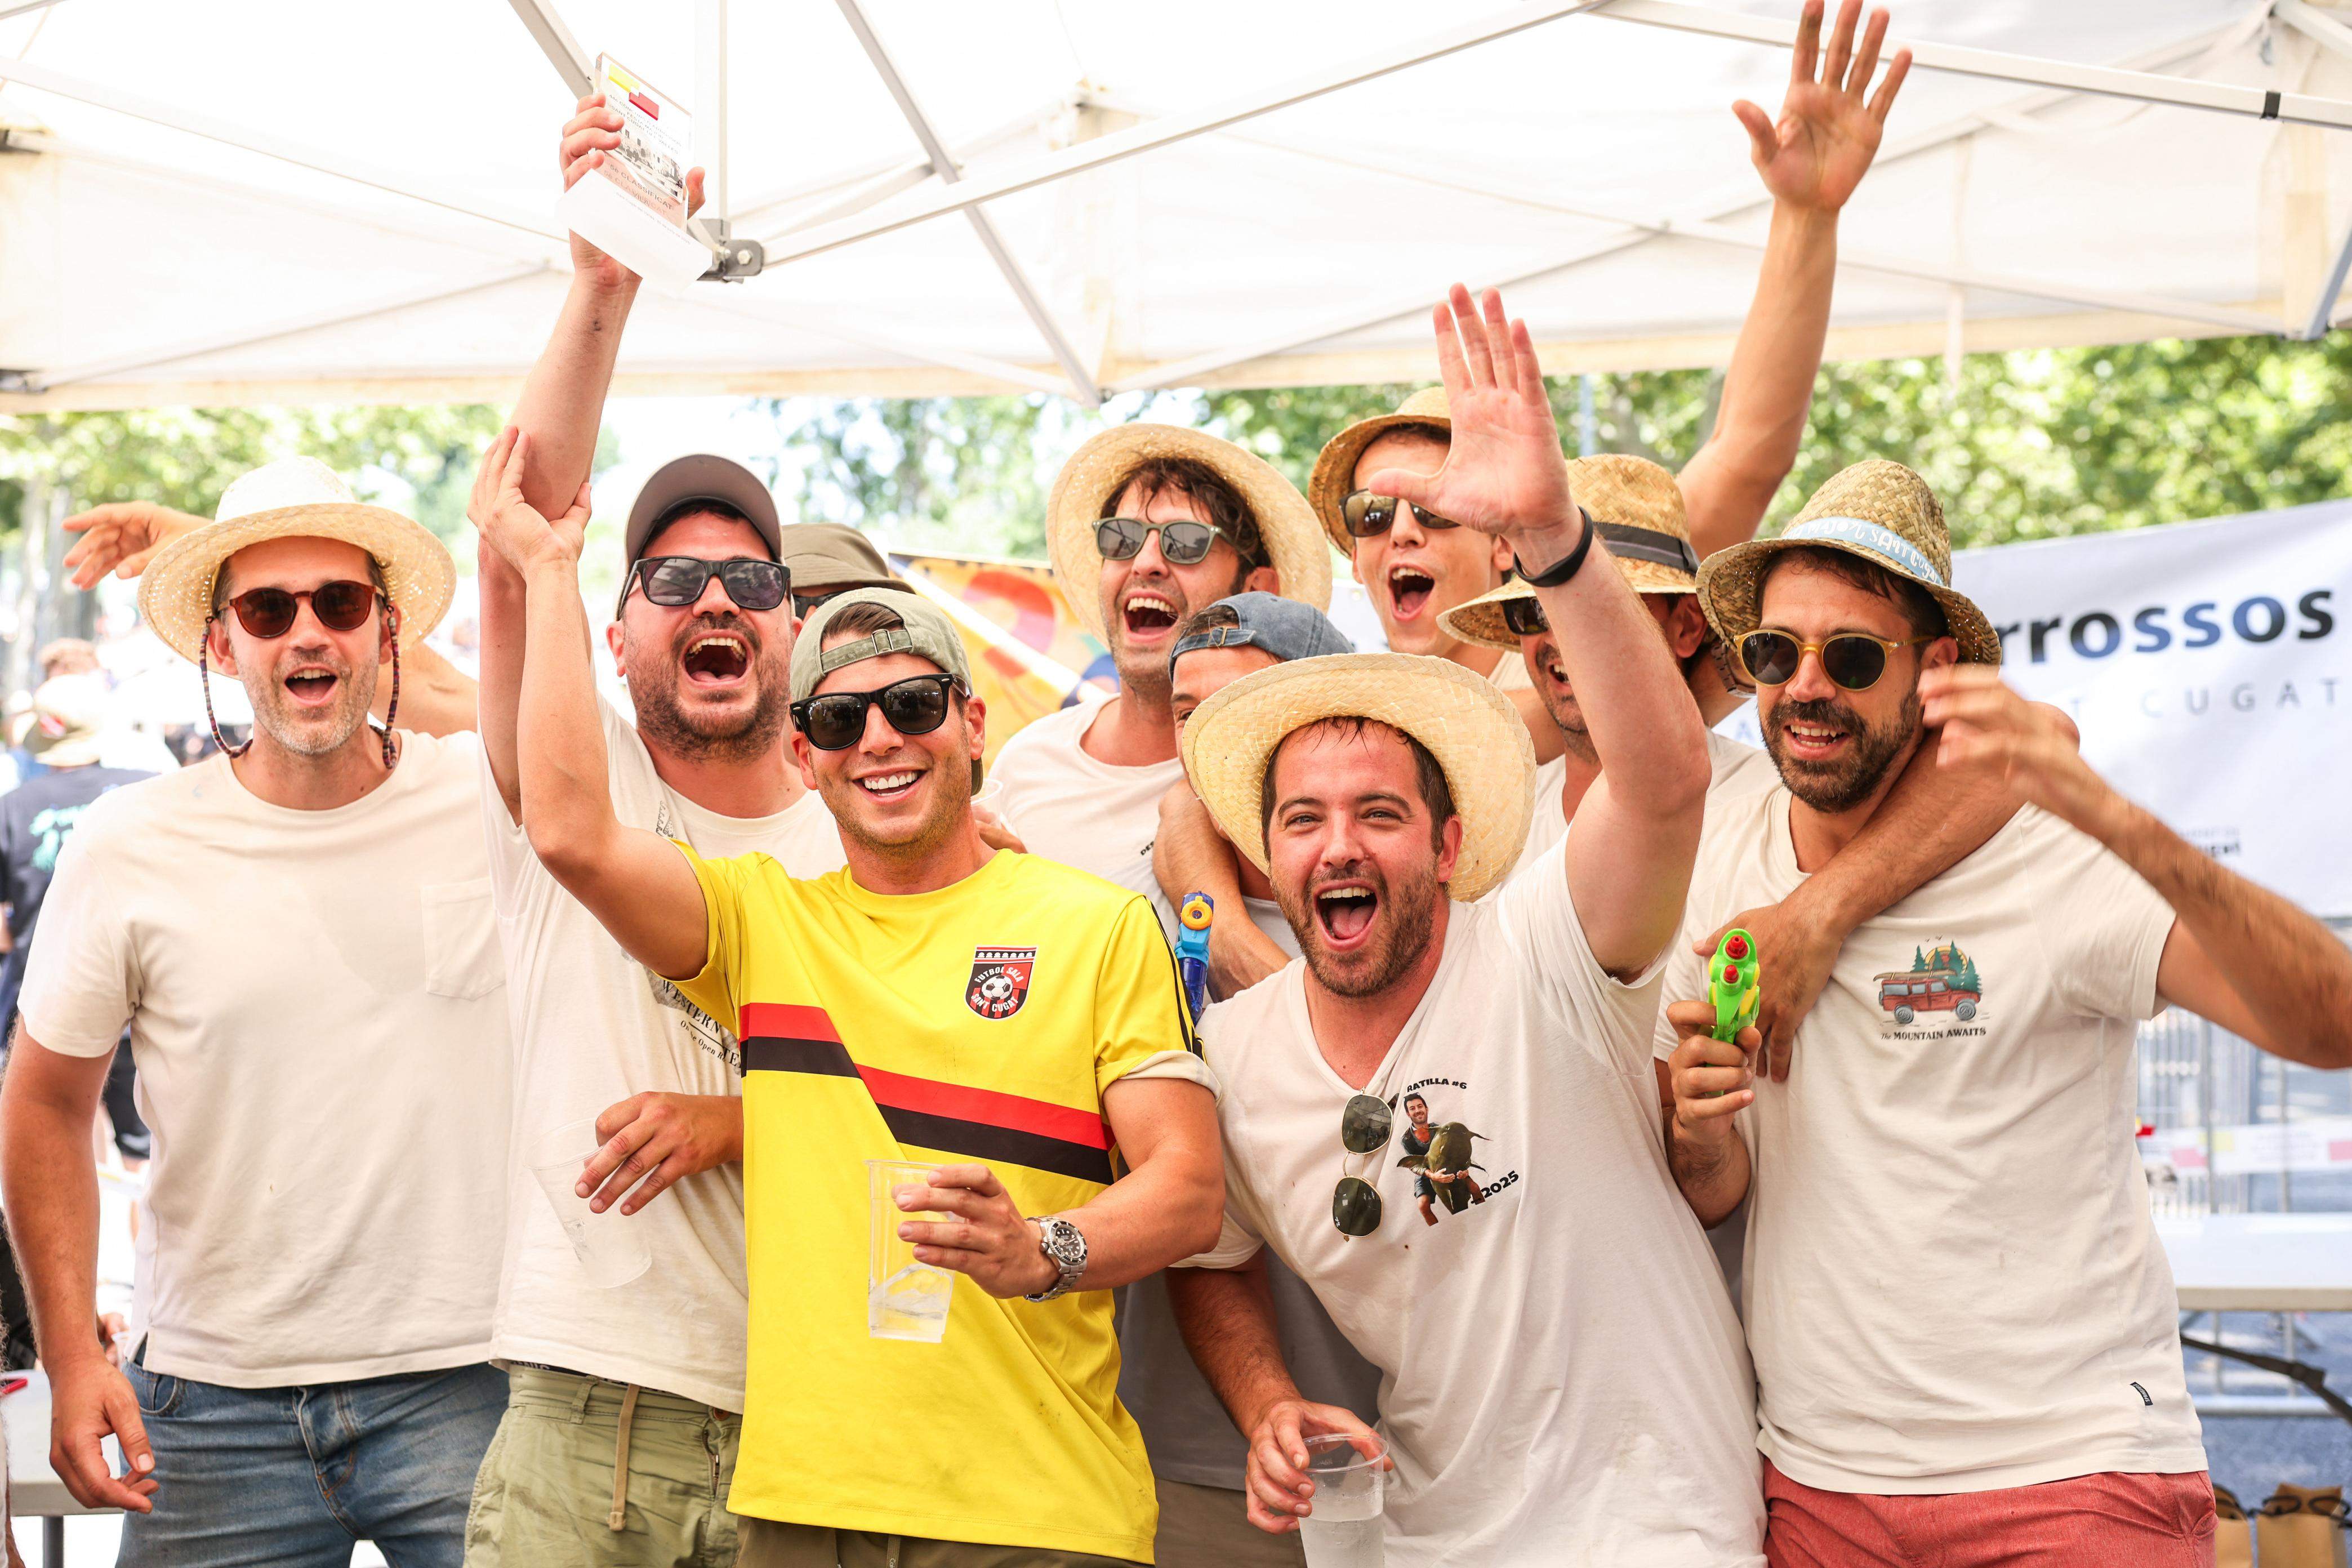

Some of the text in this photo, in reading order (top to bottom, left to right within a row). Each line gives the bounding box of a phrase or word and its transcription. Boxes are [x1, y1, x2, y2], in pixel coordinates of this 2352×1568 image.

[621, 171, 672, 211] CLASSIFICAT
[2001, 590, 2335, 665] rrossos
[2141, 676, 2340, 718] CUGAT
[974, 966, 1024, 983] FUTBOL SALA
[662, 980, 720, 1034] WESTERN
[971, 994, 1019, 1012] SANT CUGAT
[1894, 1030, 1943, 1040] MOUNTAIN
[1946, 1027, 1986, 1037] AWAITS
[698, 1039, 715, 1054] Open
[1407, 1078, 1449, 1093] RATILLA
[1481, 1170, 1518, 1198] 2025
